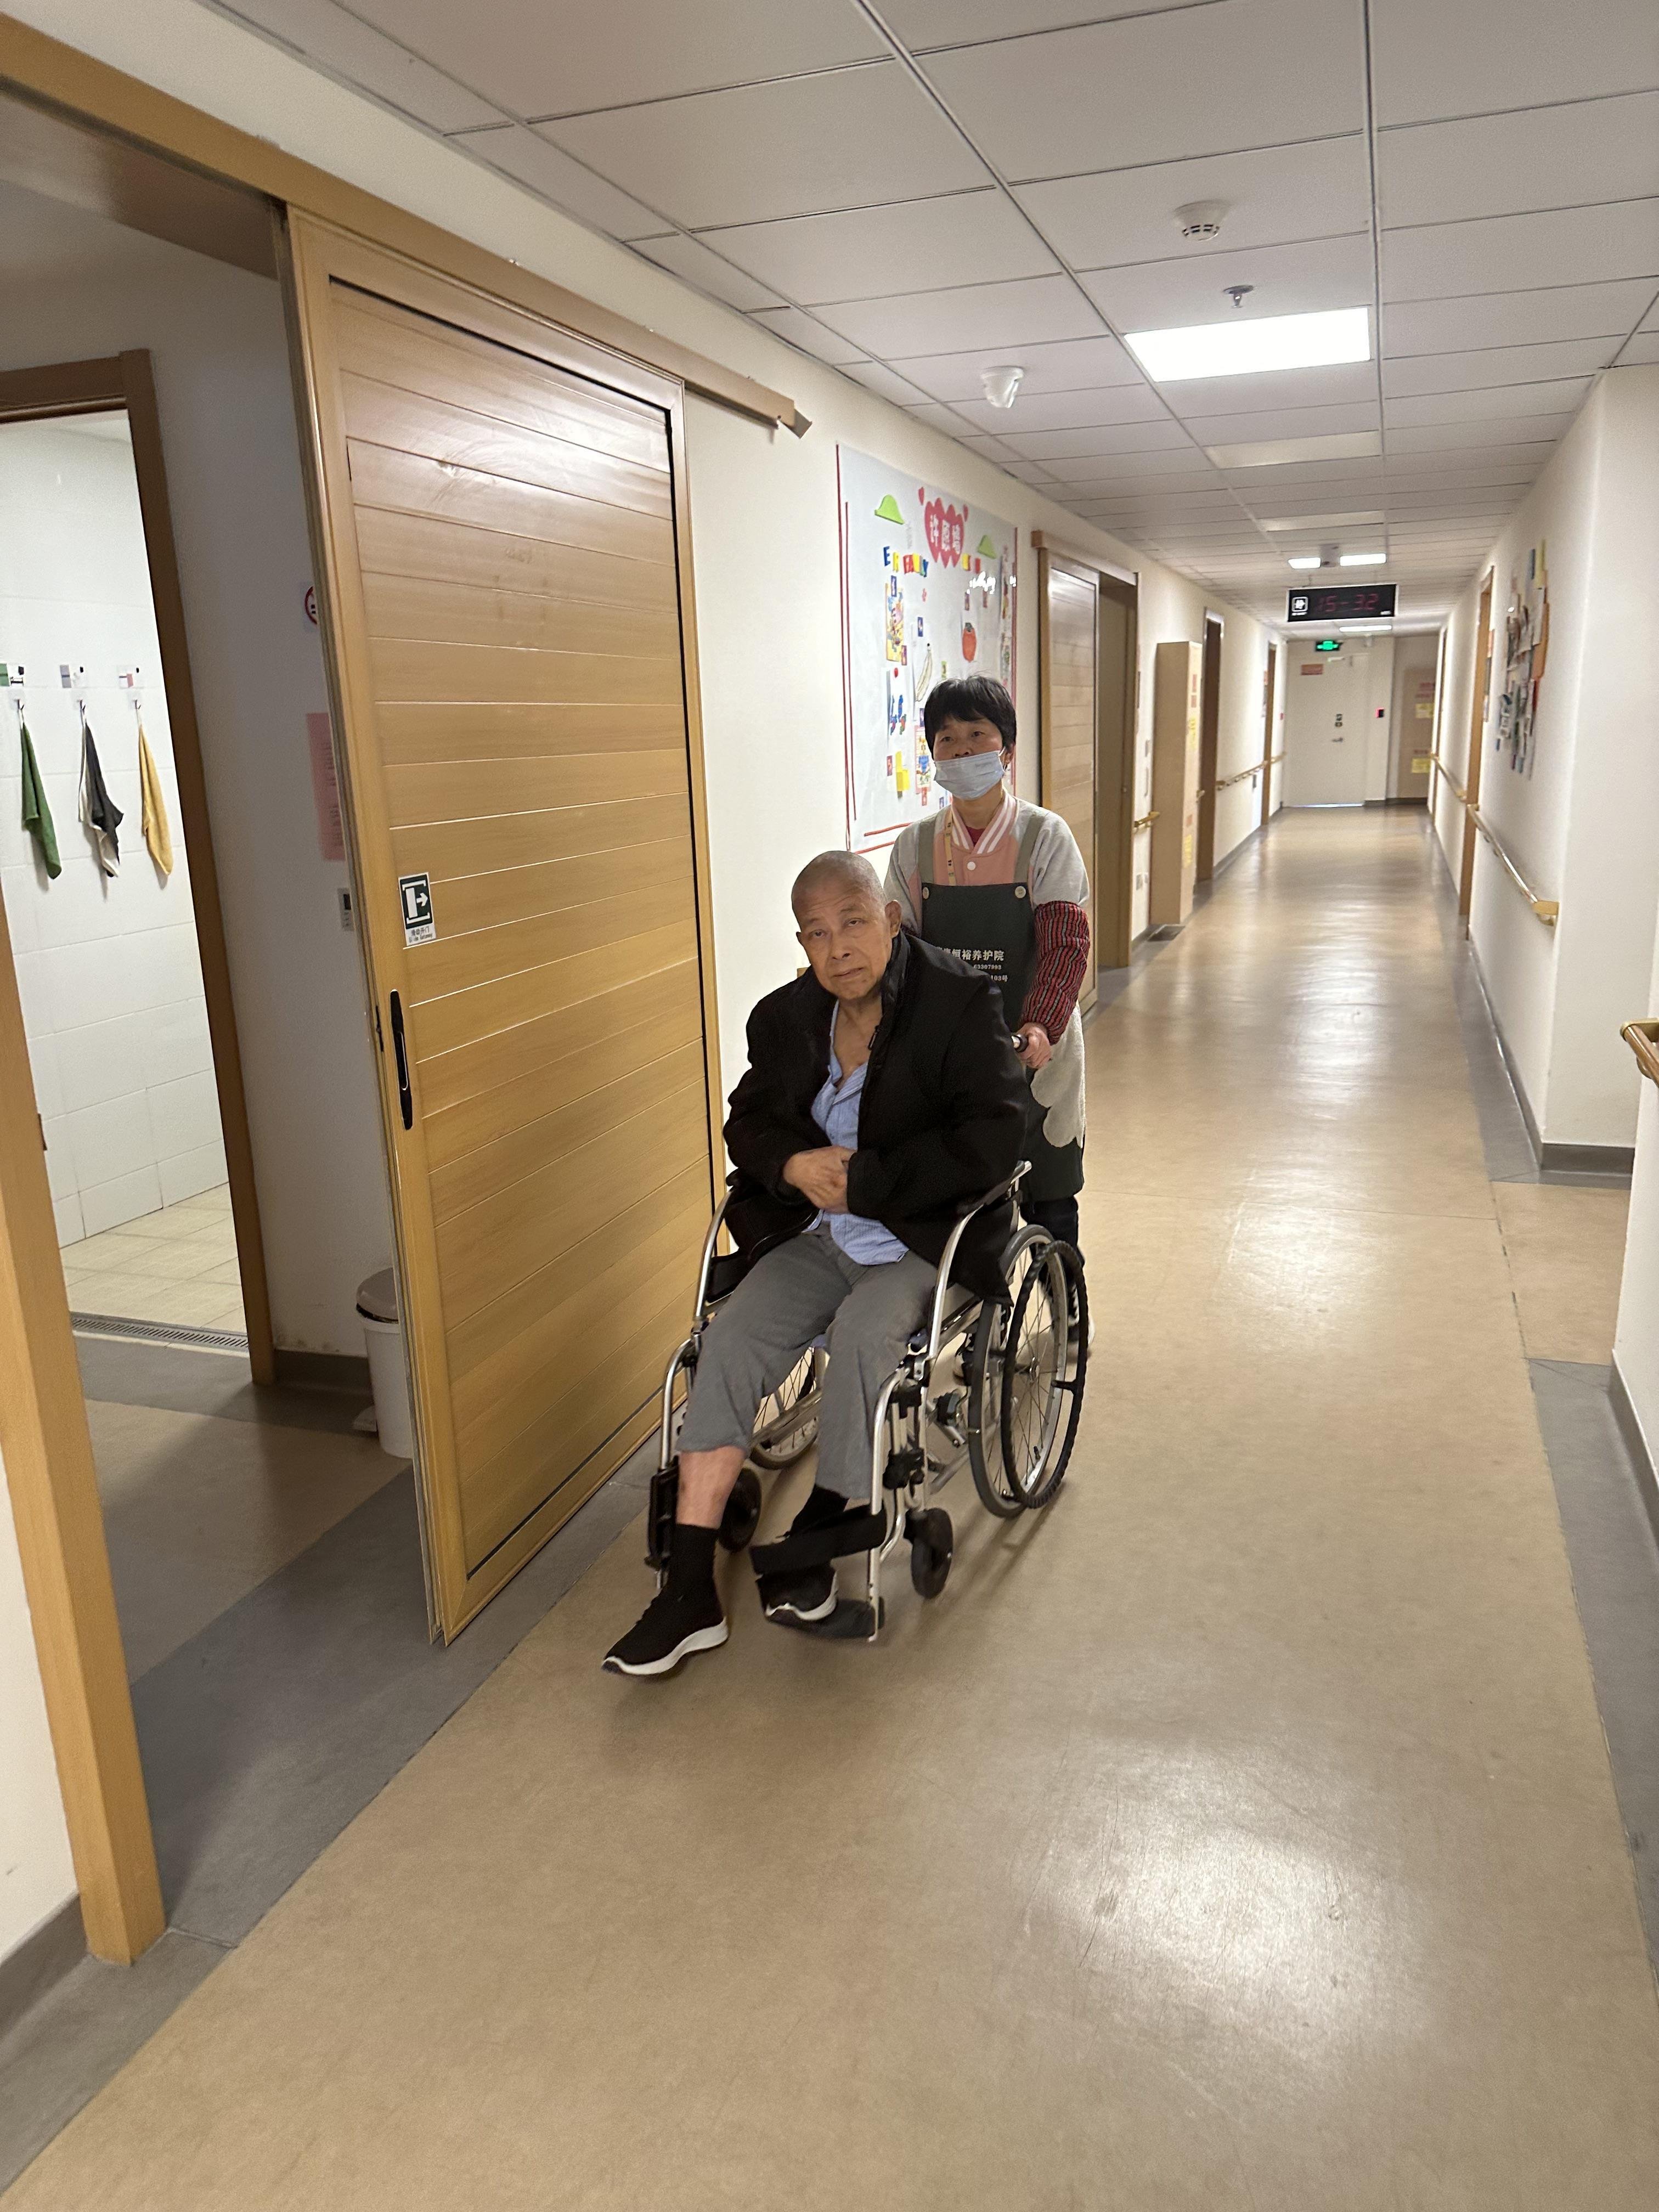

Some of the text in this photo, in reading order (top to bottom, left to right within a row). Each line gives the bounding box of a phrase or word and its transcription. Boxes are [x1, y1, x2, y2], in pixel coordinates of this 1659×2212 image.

[936, 946, 1005, 961] 恒裕养护院
